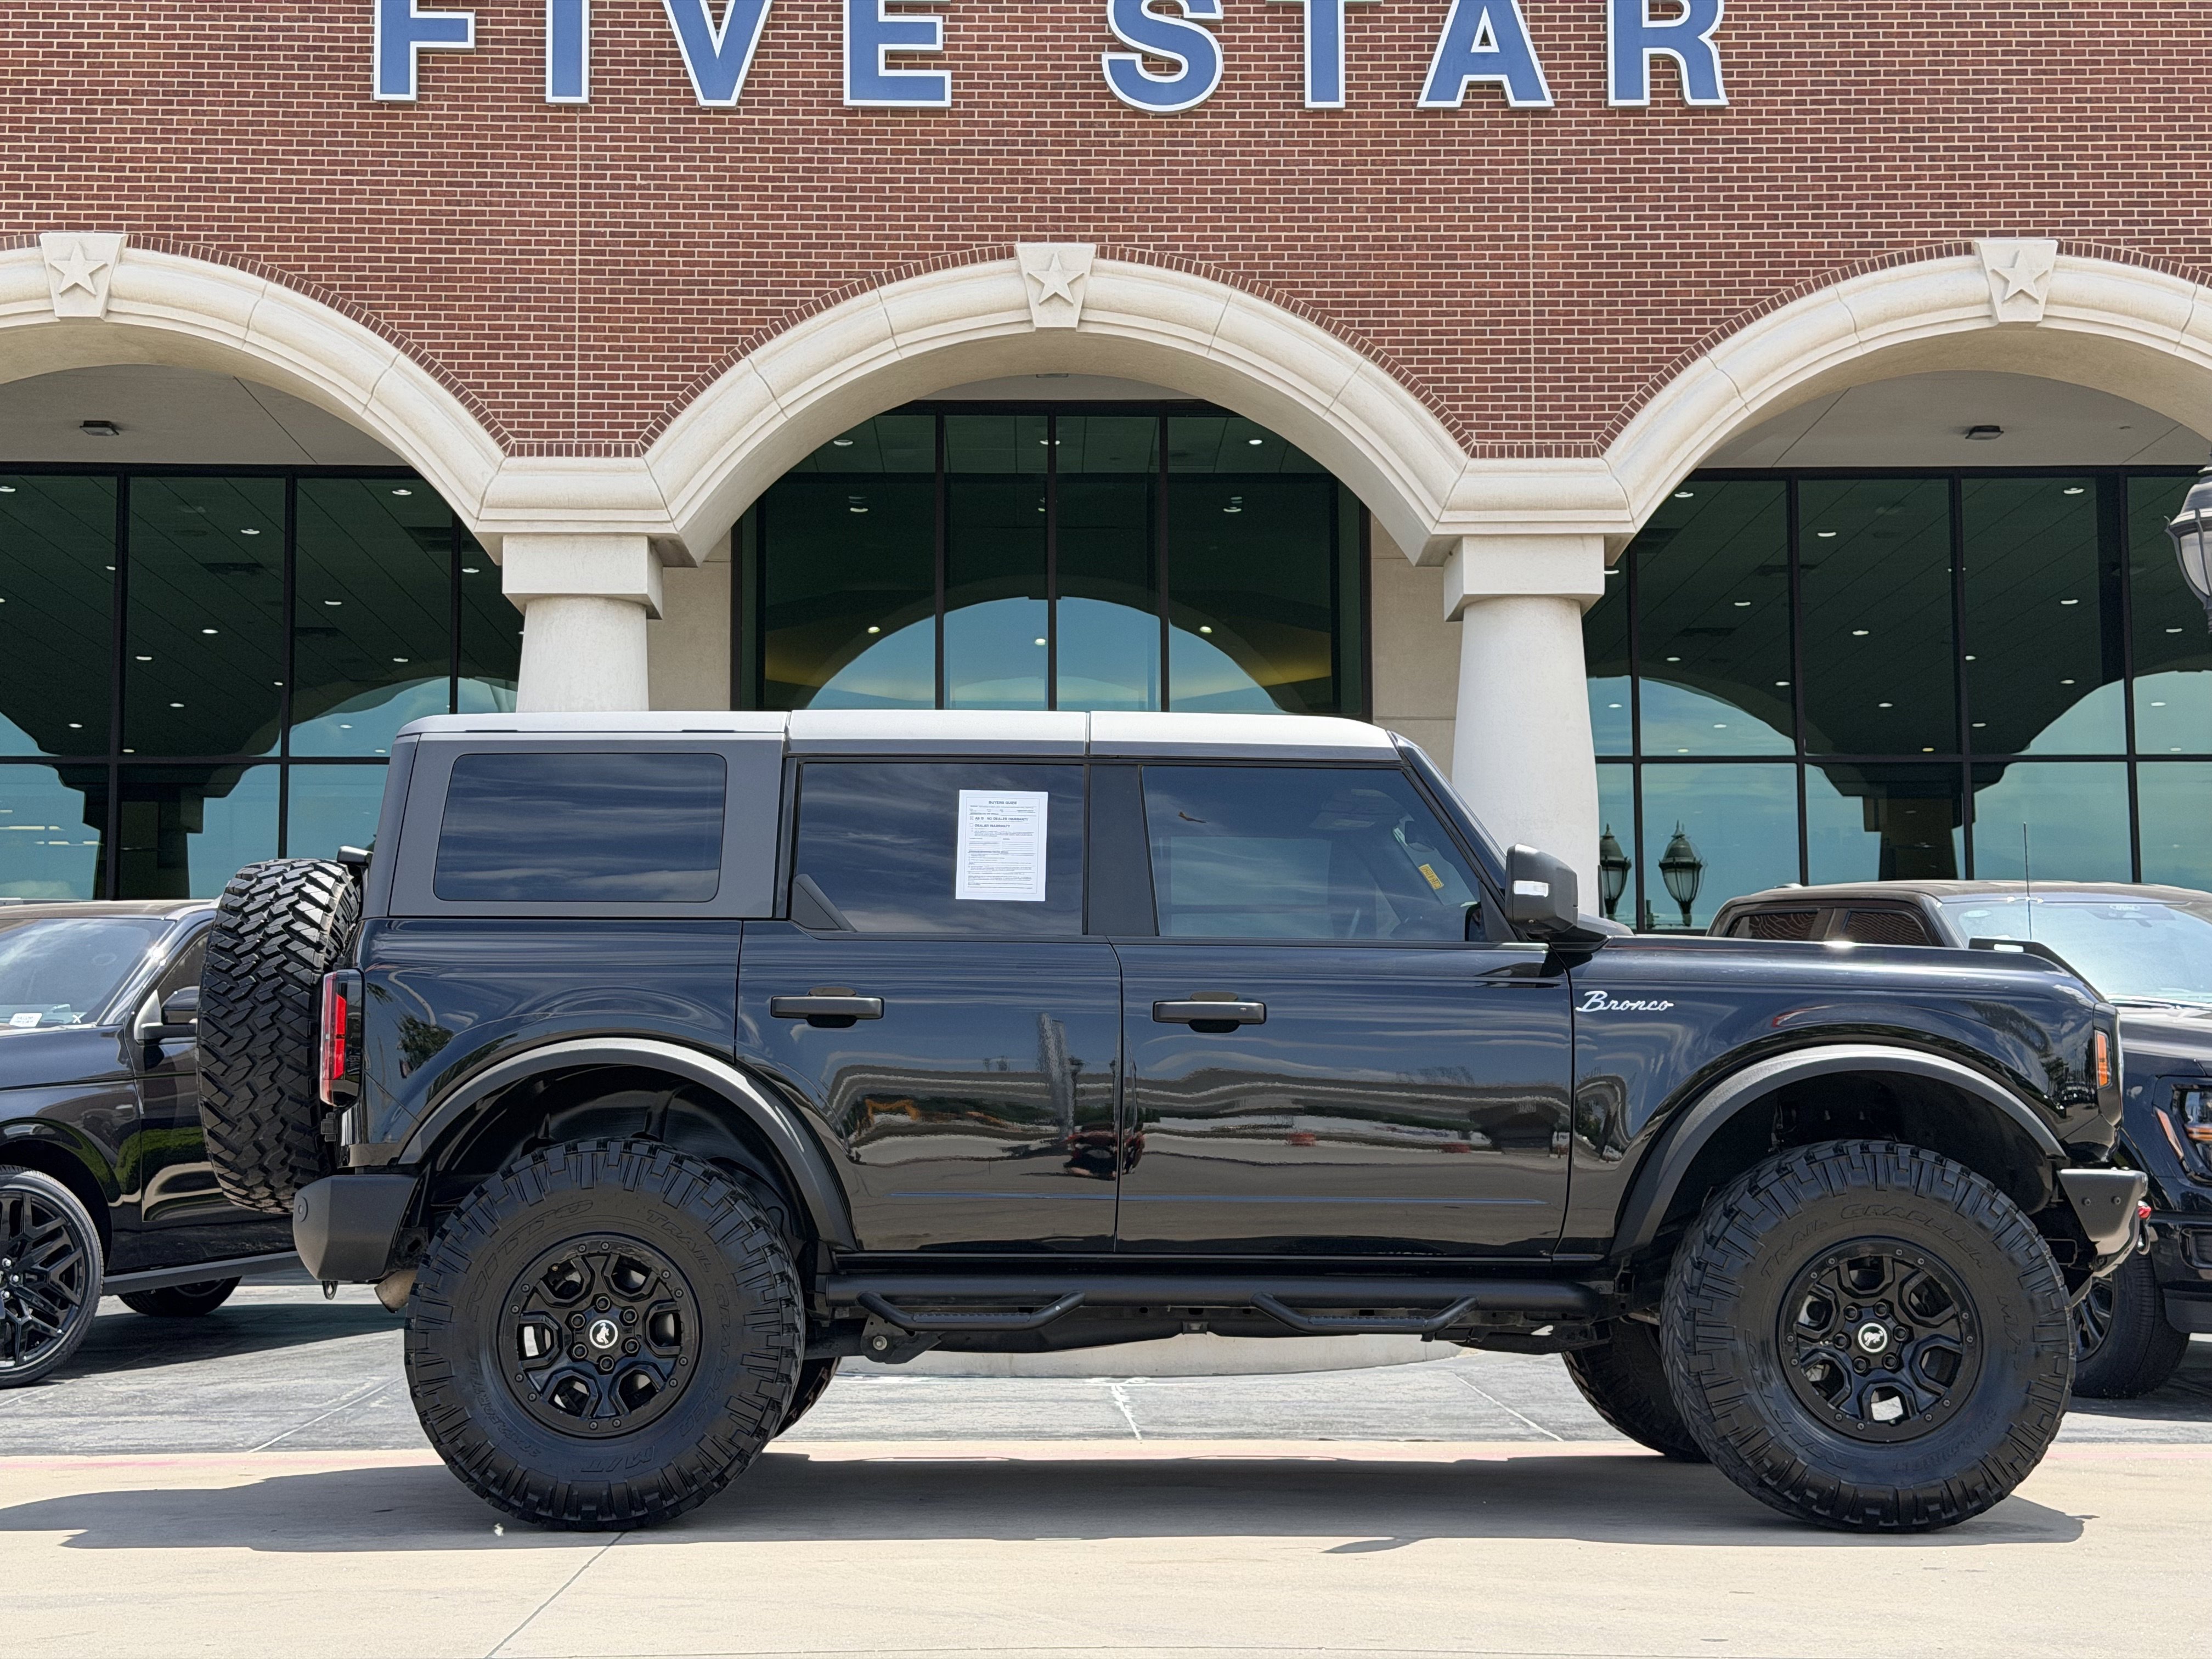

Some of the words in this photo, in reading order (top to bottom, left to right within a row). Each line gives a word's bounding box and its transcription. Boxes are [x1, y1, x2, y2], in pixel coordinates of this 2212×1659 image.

[372, 0, 952, 108] FIVE
[1101, 0, 1730, 115] STAR
[1576, 990, 1674, 1012] Bronco
[647, 1209, 712, 1273] TRAIL
[1760, 1220, 1829, 1279] TRAIL
[1841, 1203, 1988, 1271] GRAPPLER
[679, 1283, 731, 1437] GRAPPLER
[580, 1443, 656, 1472] M/T
